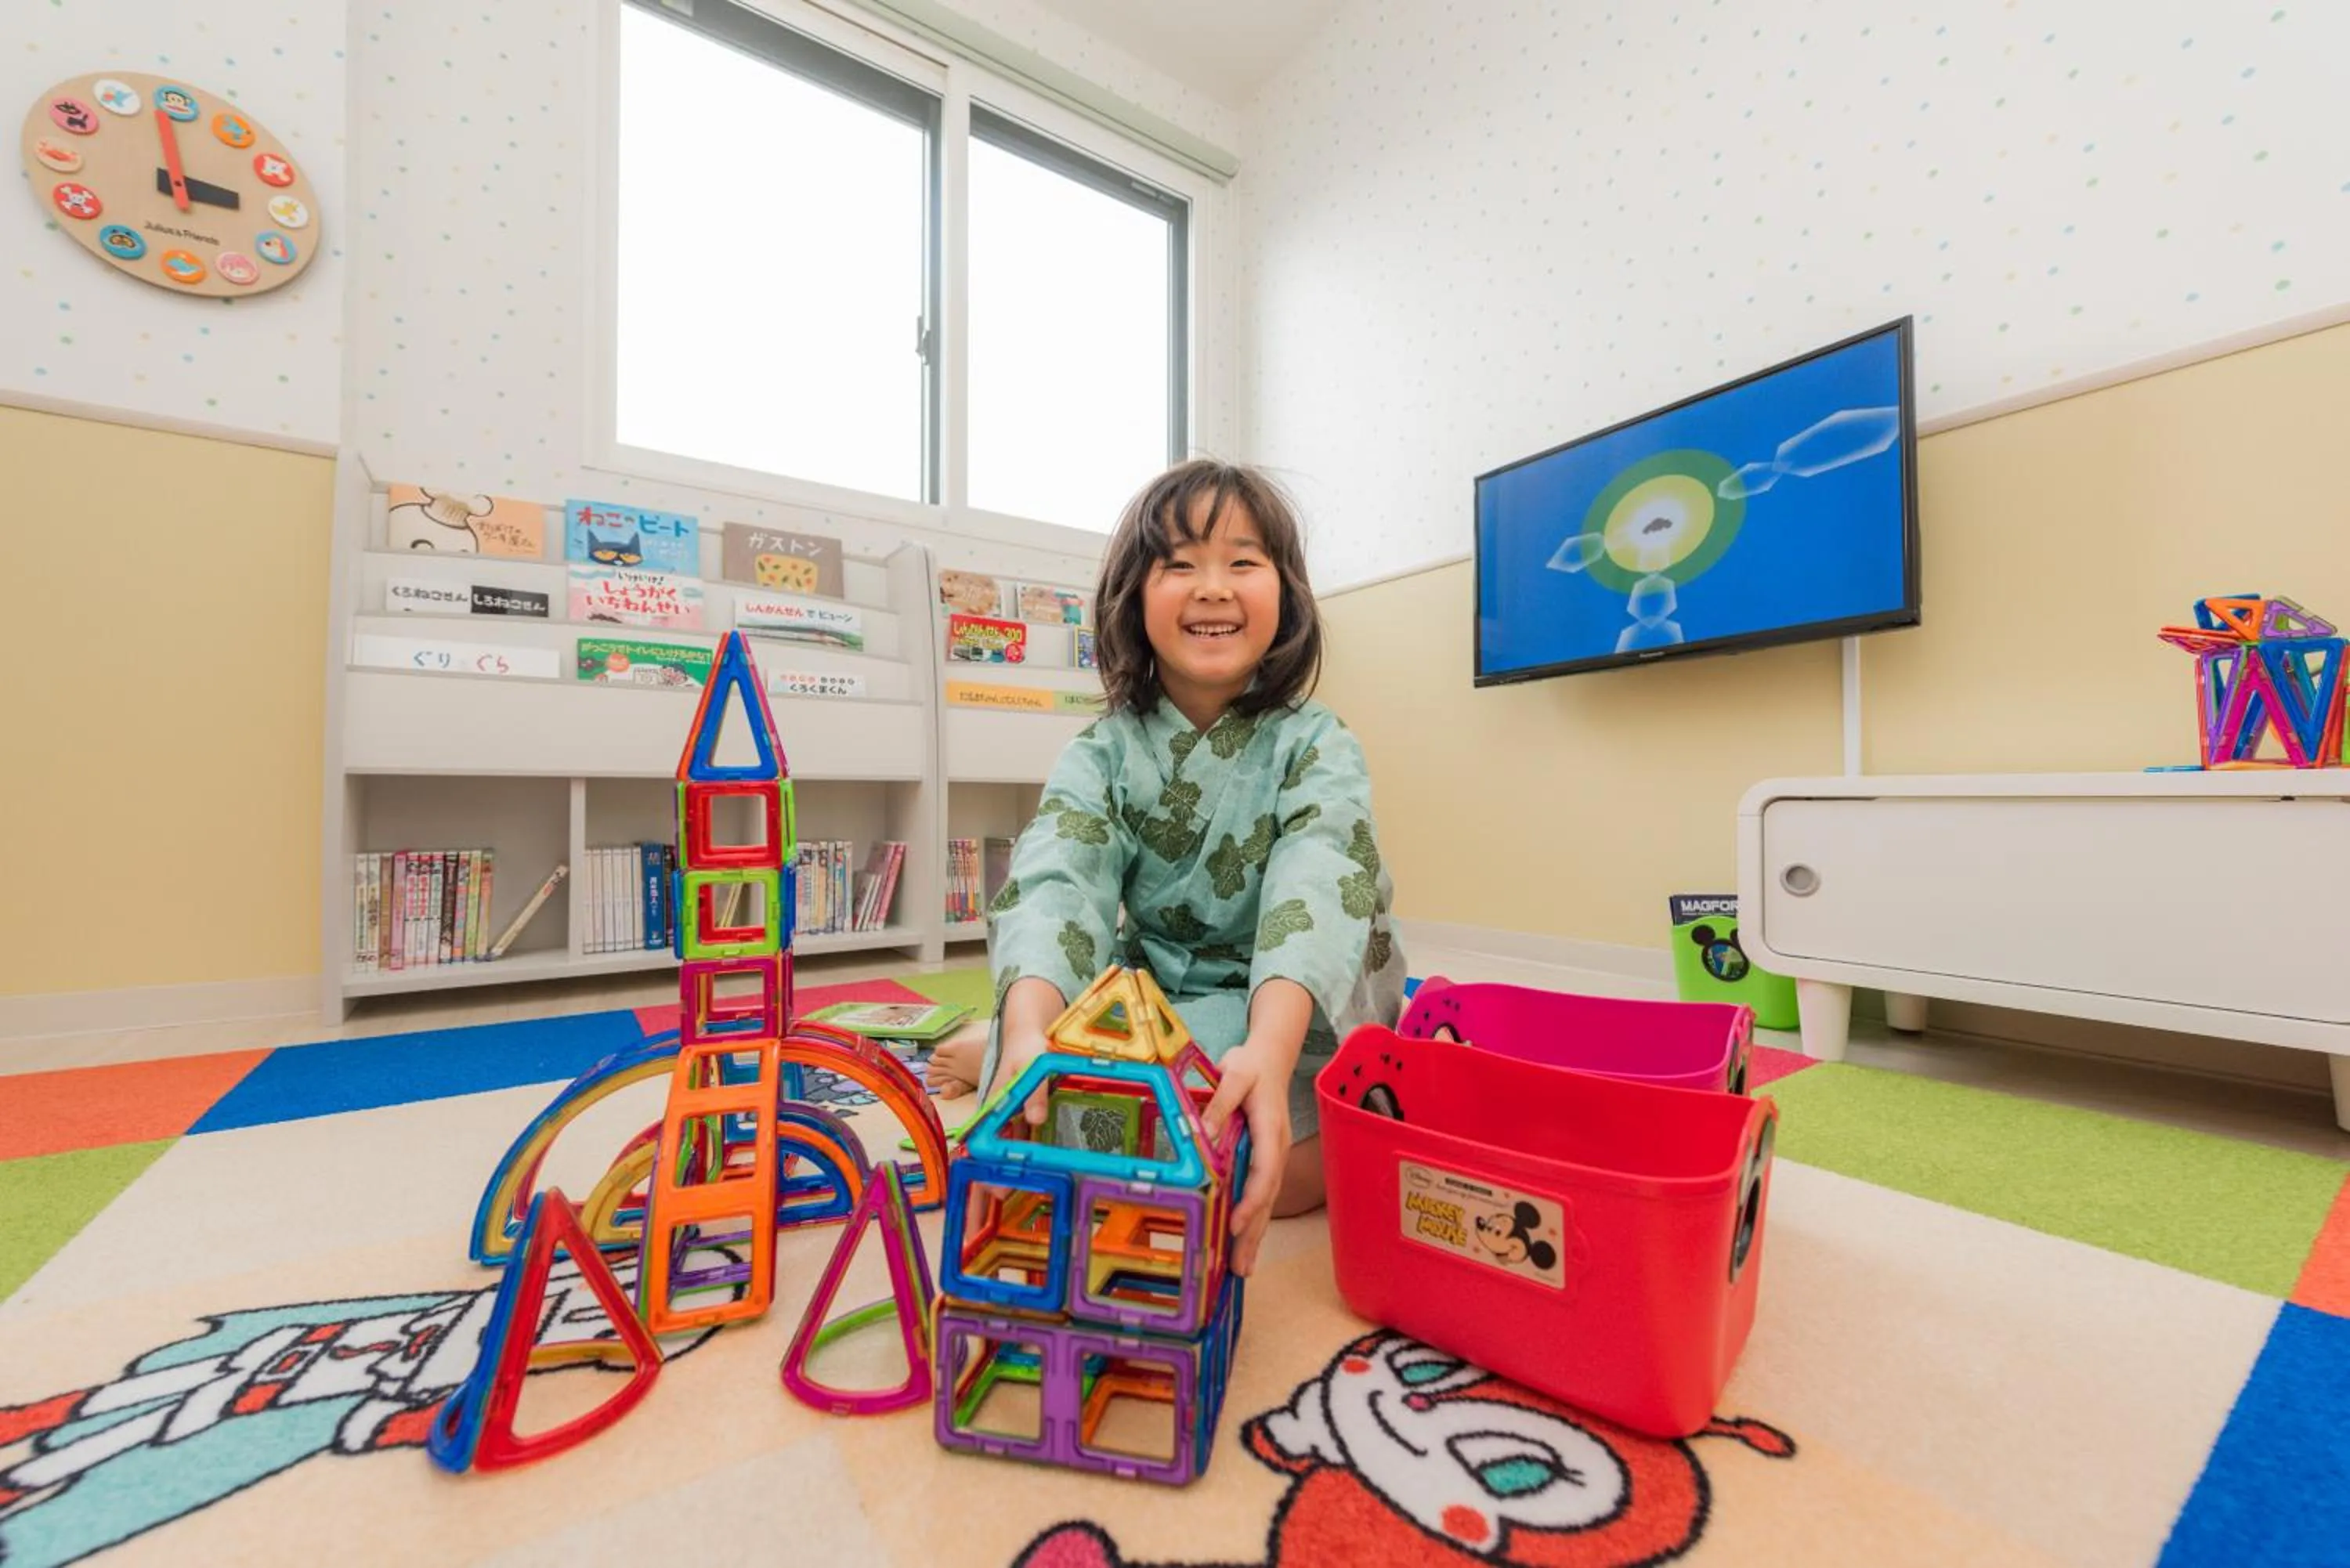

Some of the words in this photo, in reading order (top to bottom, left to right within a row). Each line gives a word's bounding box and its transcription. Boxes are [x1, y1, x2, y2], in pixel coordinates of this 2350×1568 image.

[748, 532, 823, 558] ガストン
[392, 586, 469, 602] くろねこさん
[473, 593, 546, 612] しろねこさん
